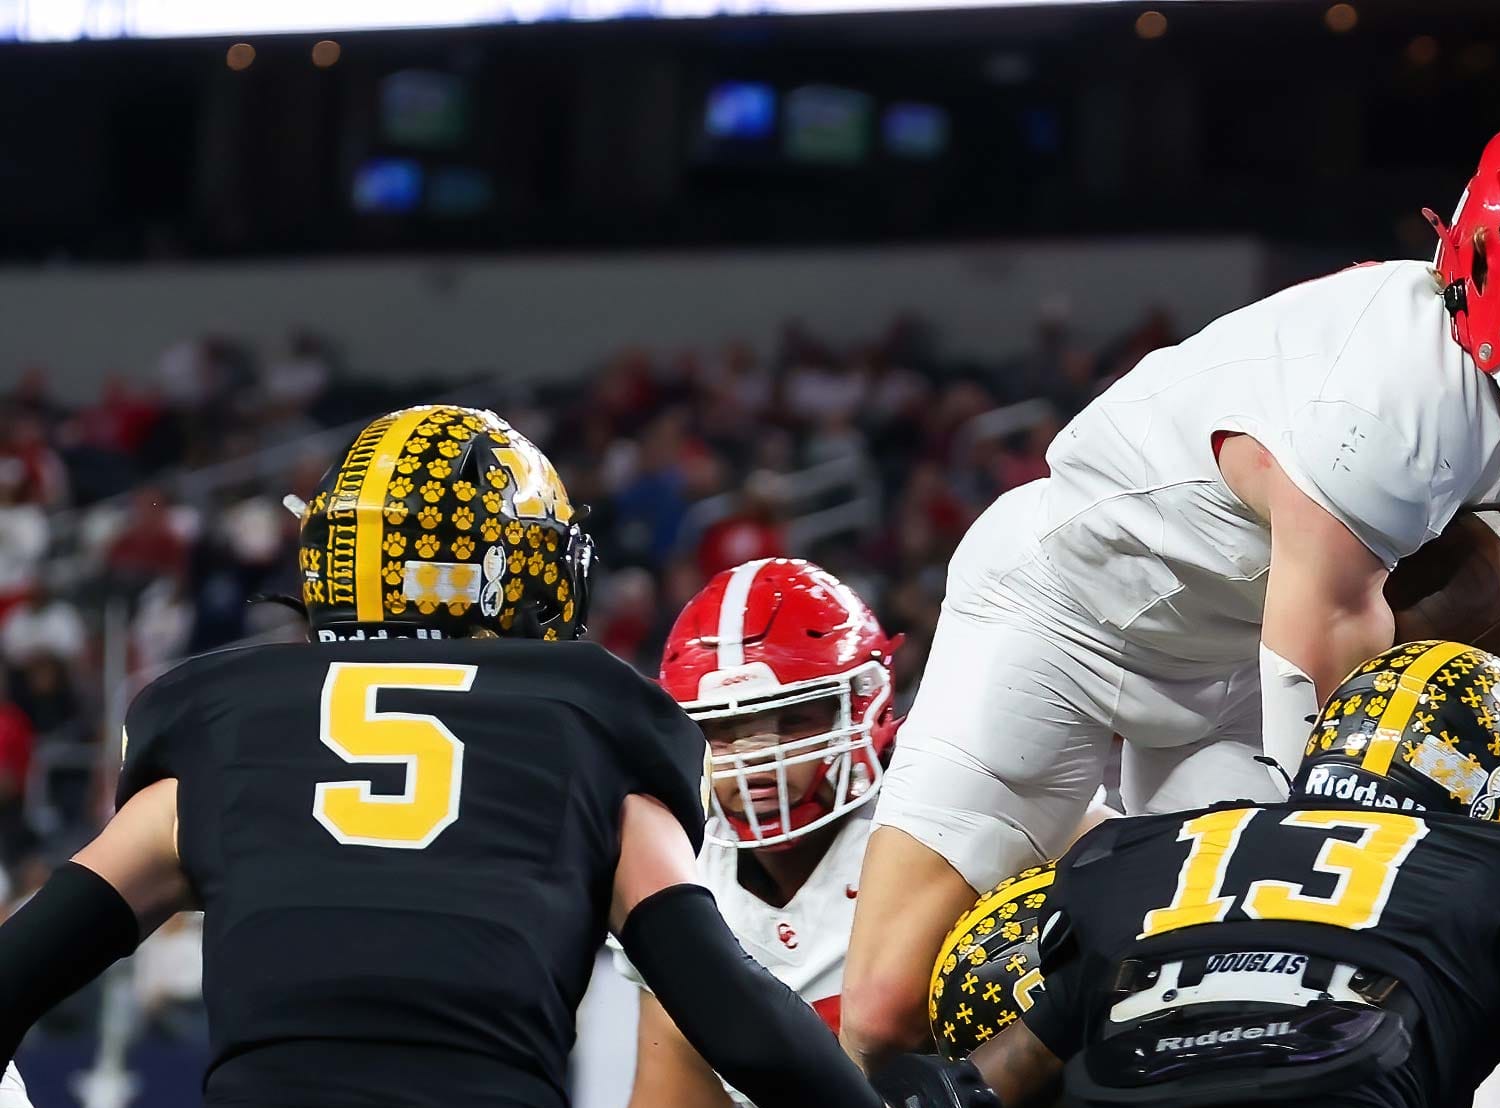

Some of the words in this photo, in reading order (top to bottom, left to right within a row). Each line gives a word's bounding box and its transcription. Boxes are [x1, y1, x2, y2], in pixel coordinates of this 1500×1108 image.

[313, 661, 478, 850] 5
[1135, 807, 1430, 941] 13
[1206, 953, 1307, 976] DOUGLAS
